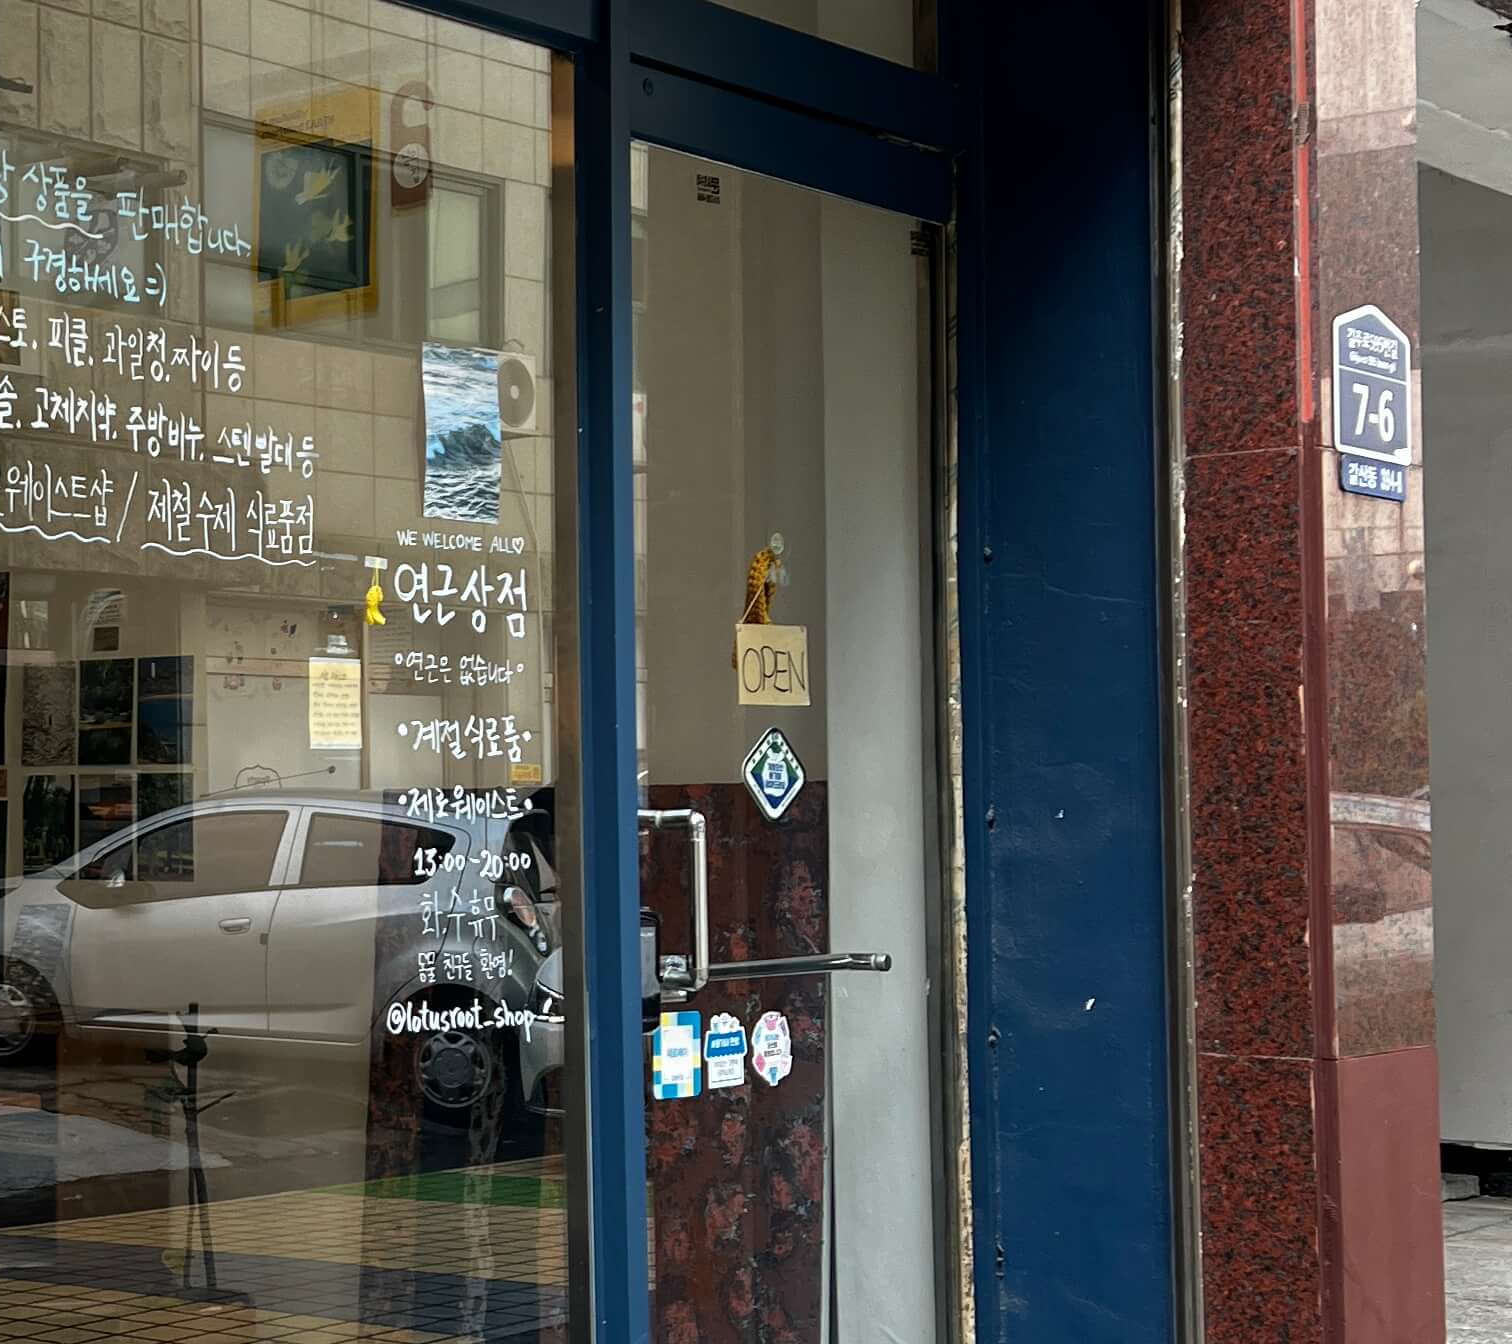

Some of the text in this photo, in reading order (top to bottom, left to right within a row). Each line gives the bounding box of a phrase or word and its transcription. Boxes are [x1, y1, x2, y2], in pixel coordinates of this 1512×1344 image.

[22, 162, 93, 222] 상품을
[1352, 383, 1395, 443] 7-6
[246, 490, 314, 557] 식료품점
[396, 529, 418, 547] WE
[423, 531, 483, 552] WELCOME
[394, 561, 528, 639] 연근상점
[741, 645, 806, 694] OPEN
[443, 952, 473, 982] 친구들
